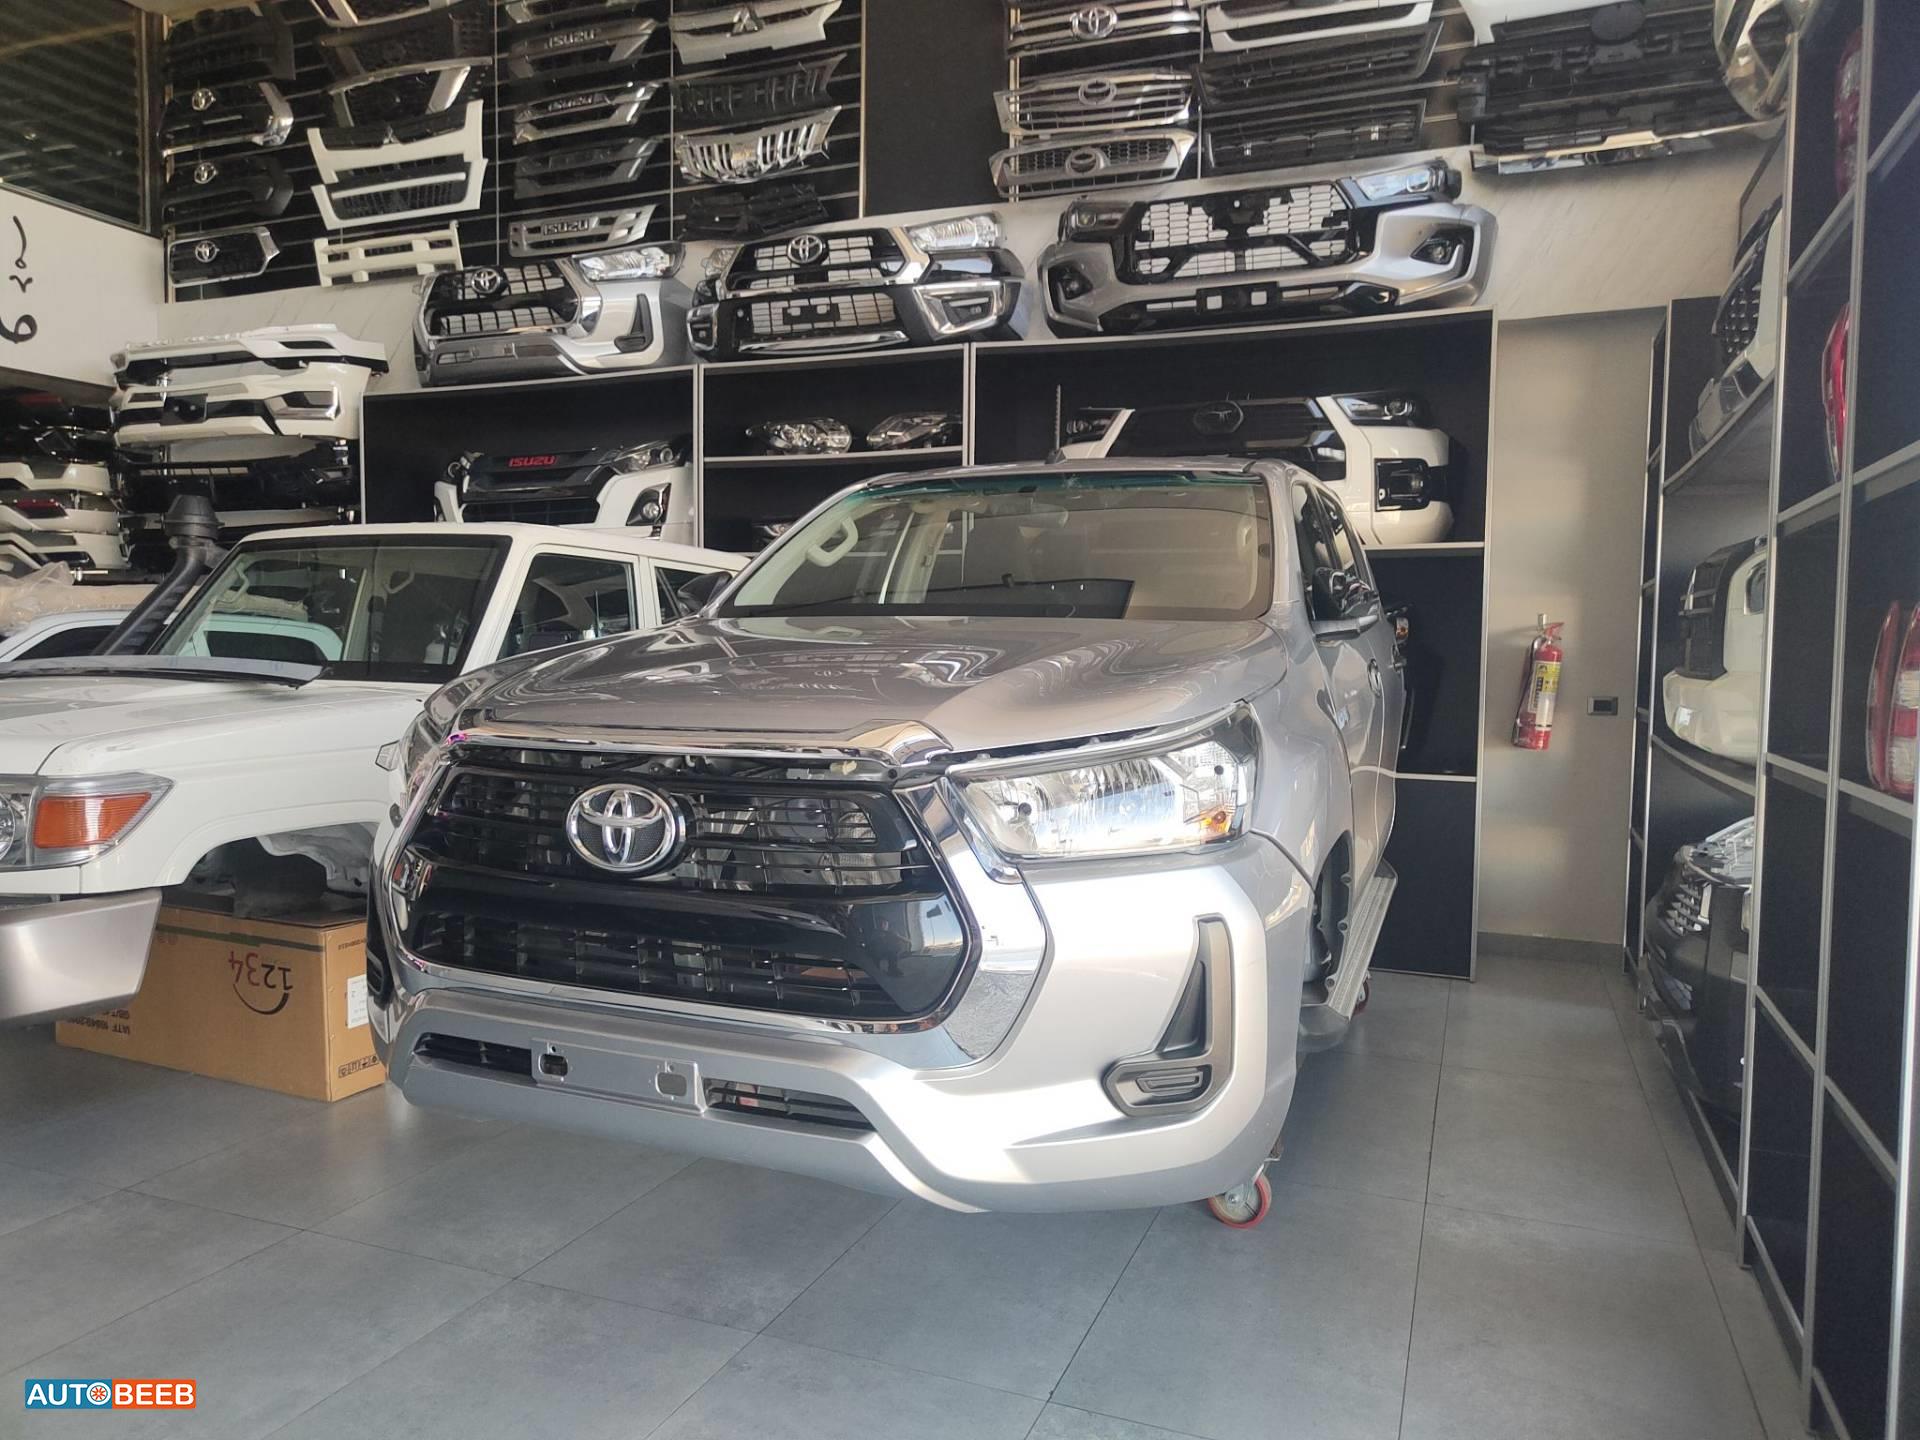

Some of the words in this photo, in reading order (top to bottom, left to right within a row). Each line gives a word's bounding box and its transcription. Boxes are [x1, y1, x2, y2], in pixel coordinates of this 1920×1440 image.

[549, 29, 596, 48] ISUZU
[543, 219, 590, 236] ISUZU
[508, 455, 557, 468] ISUZU
